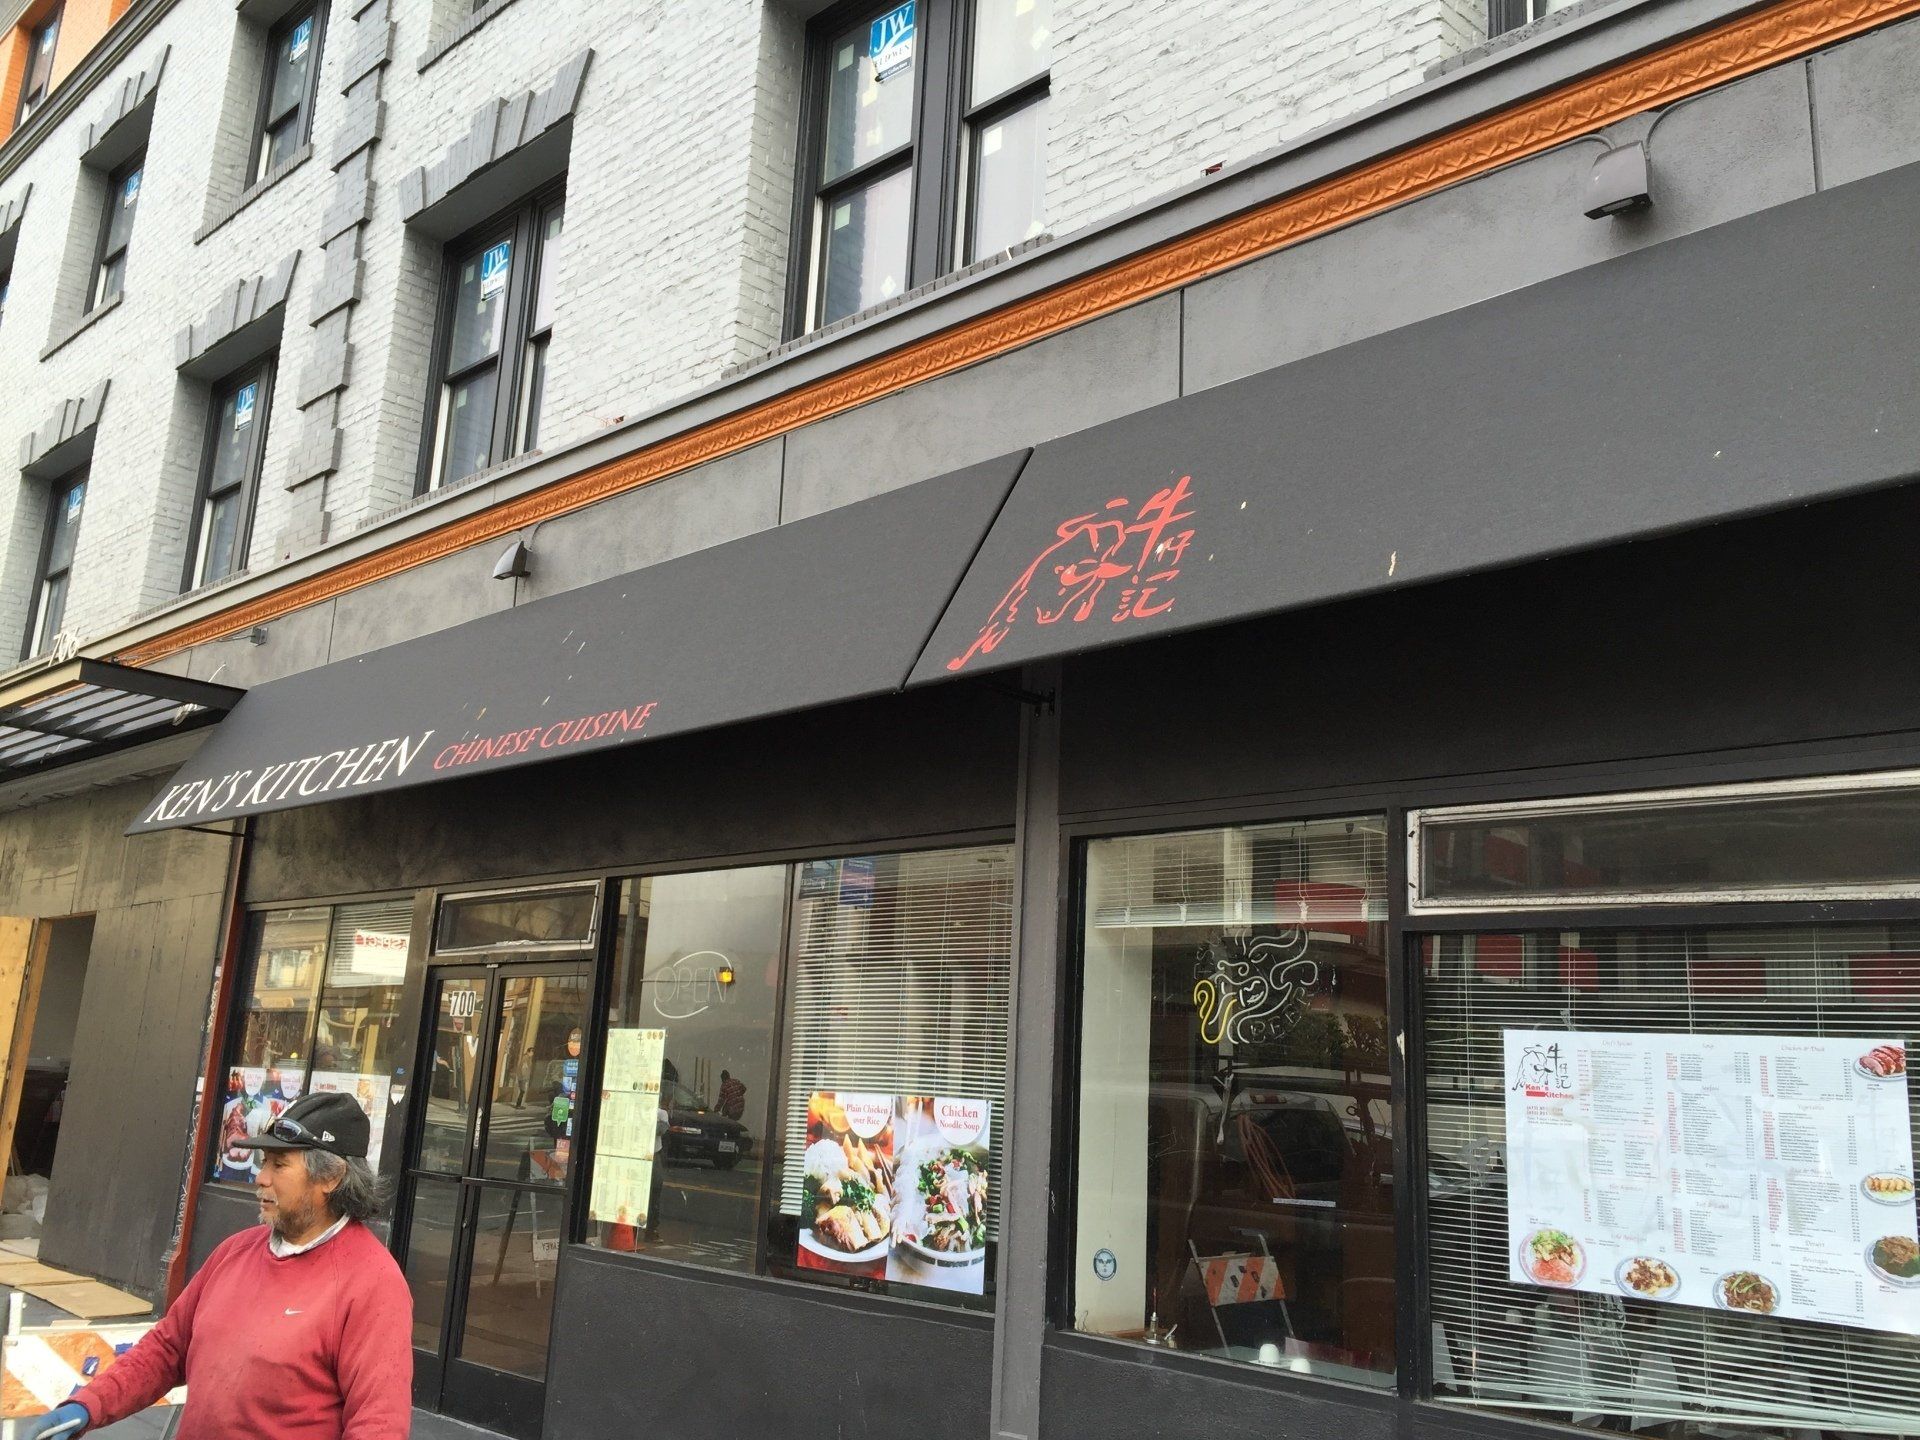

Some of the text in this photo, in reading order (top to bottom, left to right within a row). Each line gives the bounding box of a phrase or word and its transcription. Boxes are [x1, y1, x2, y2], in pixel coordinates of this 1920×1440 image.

[48, 626, 80, 667] 706
[433, 701, 658, 770] CHINESE CUISINE
[143, 730, 435, 824] KEN'S KITCHEN
[655, 966, 727, 1003] OPEN
[452, 991, 474, 1016] 700
[1525, 1083, 1549, 1091] Ken's
[846, 1103, 888, 1114] Plain Chicken
[941, 1105, 978, 1118] Chicken
[867, 1116, 880, 1125] Rice
[939, 1119, 980, 1132] Noodle Soup
